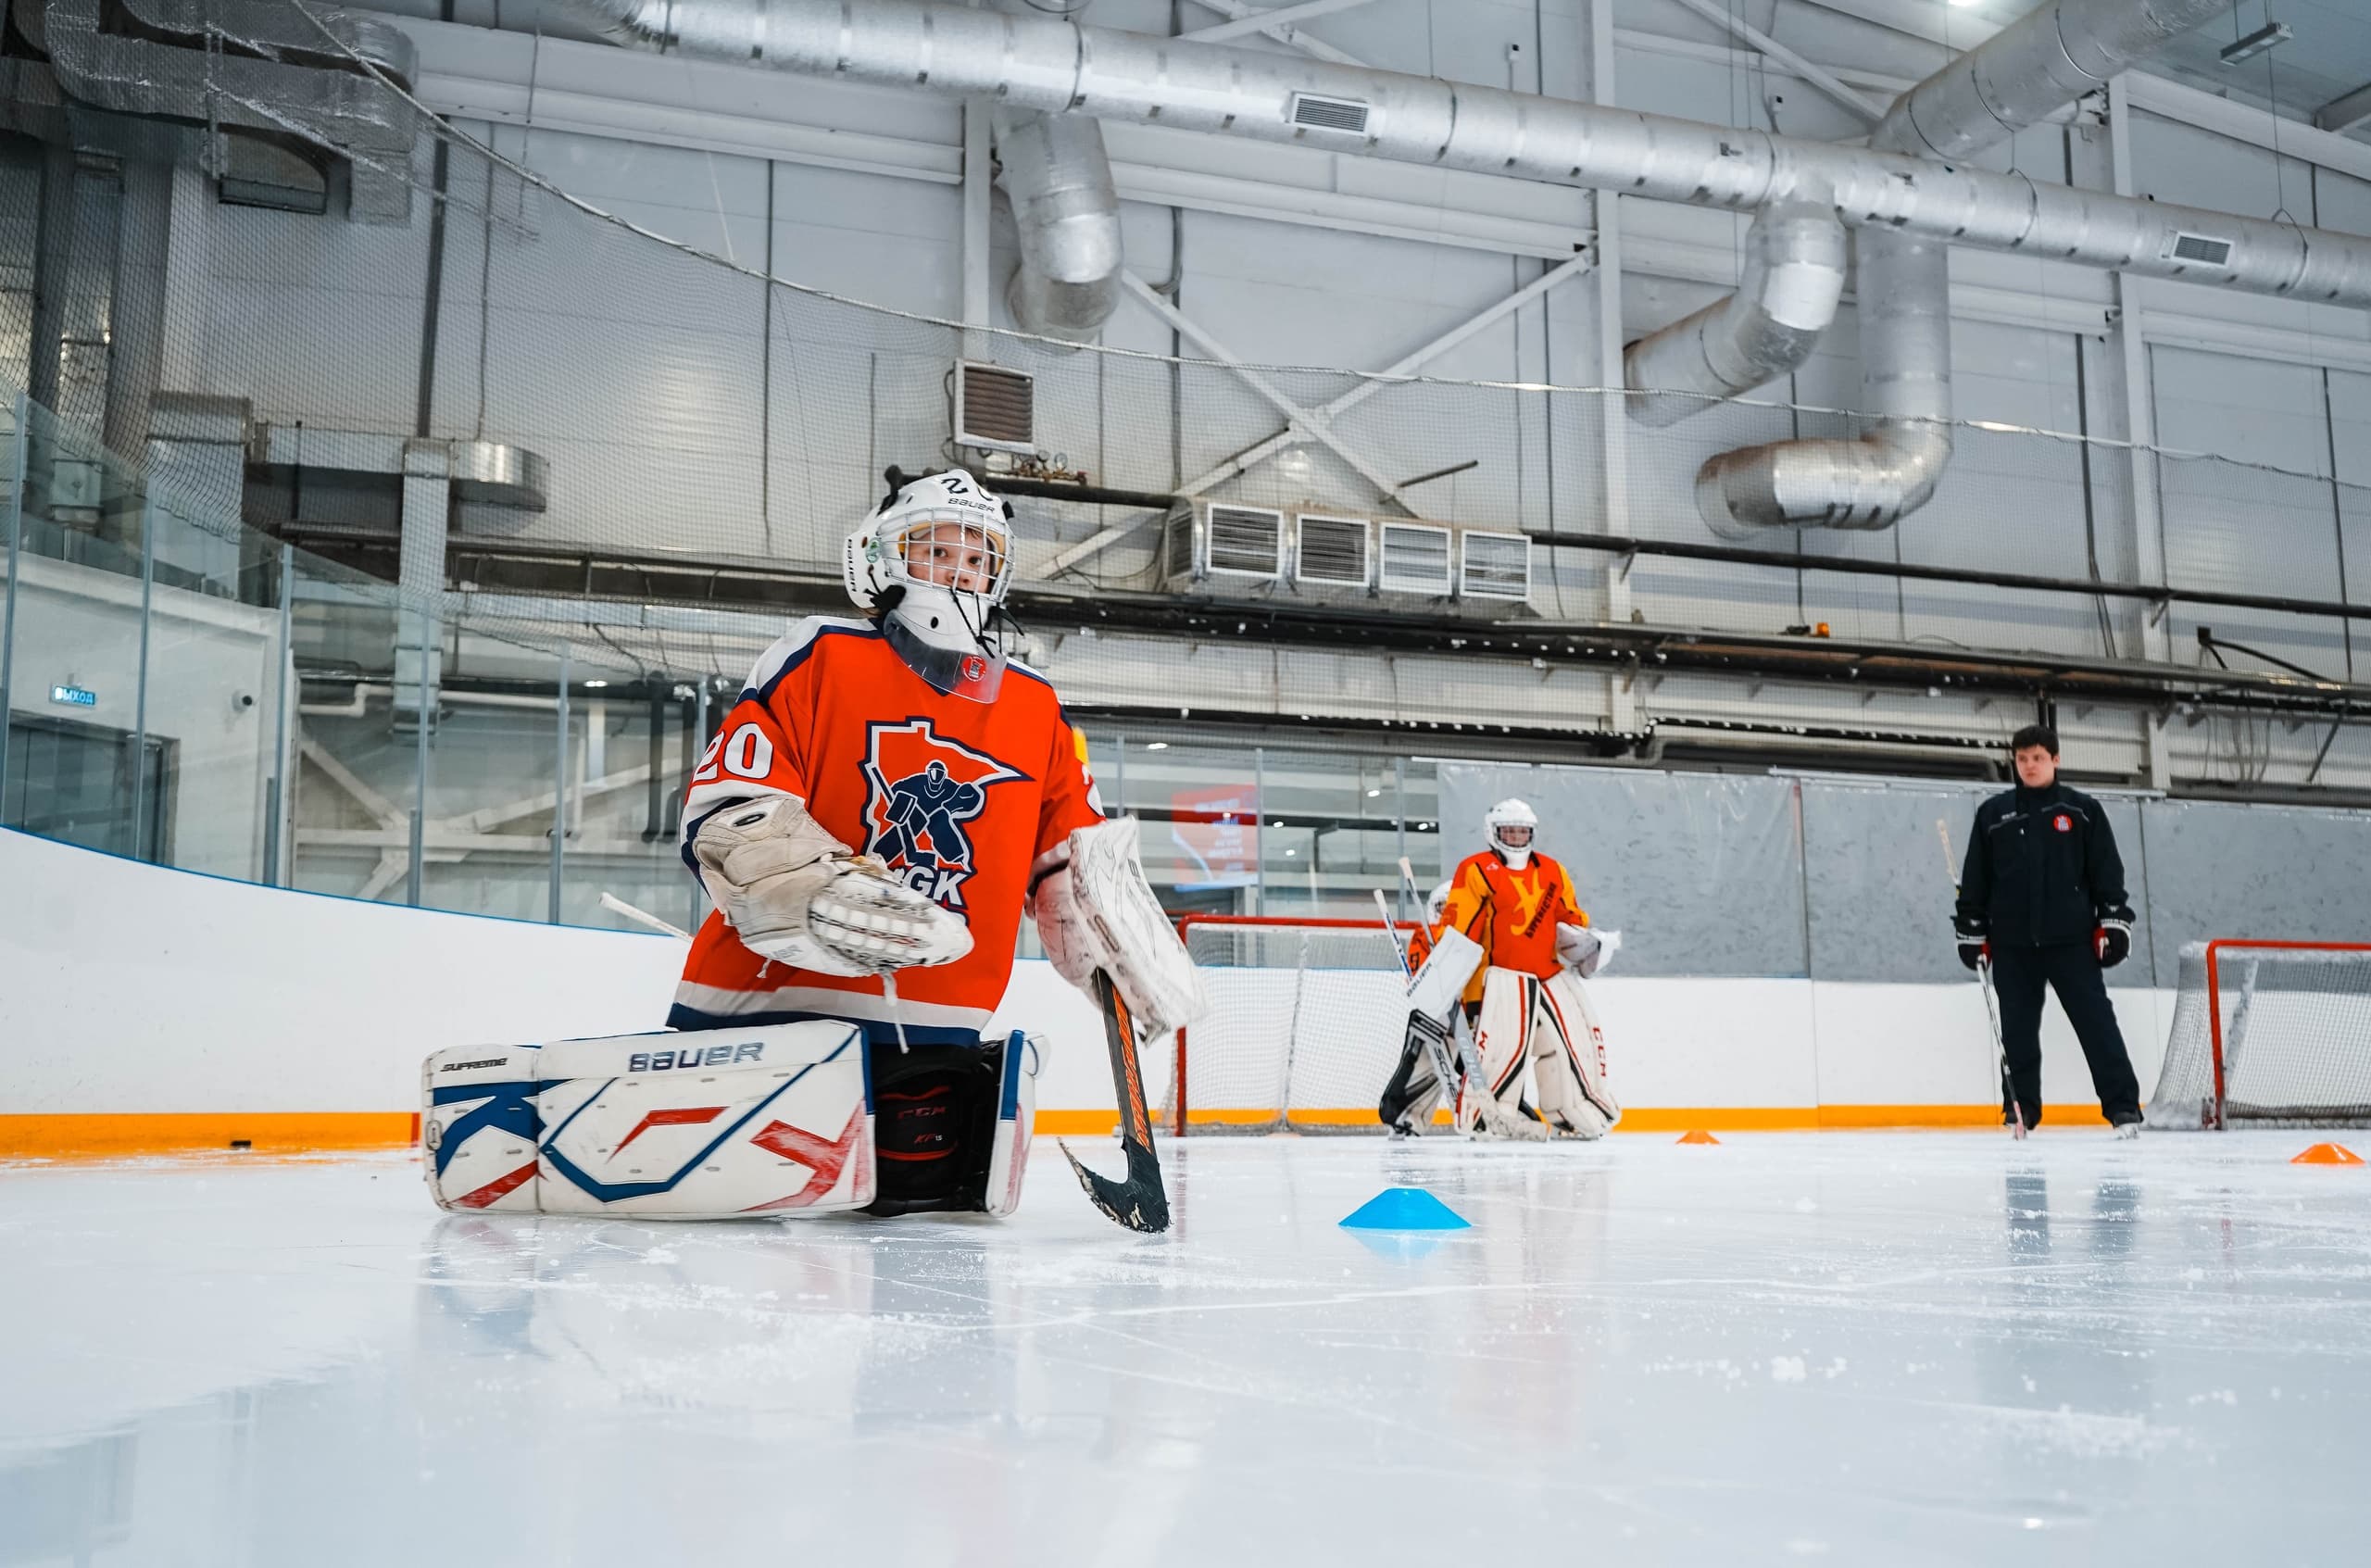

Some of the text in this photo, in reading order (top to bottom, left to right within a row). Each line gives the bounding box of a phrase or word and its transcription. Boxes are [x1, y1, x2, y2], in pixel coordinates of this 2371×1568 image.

[947, 497, 995, 512] BAUER
[847, 538, 858, 593] BAUER
[692, 723, 773, 784] 20
[1406, 962, 1433, 997] BAUER
[439, 1057, 508, 1073] SUPREME
[628, 1042, 764, 1073] BAUER
[1592, 1026, 1607, 1077] CCM
